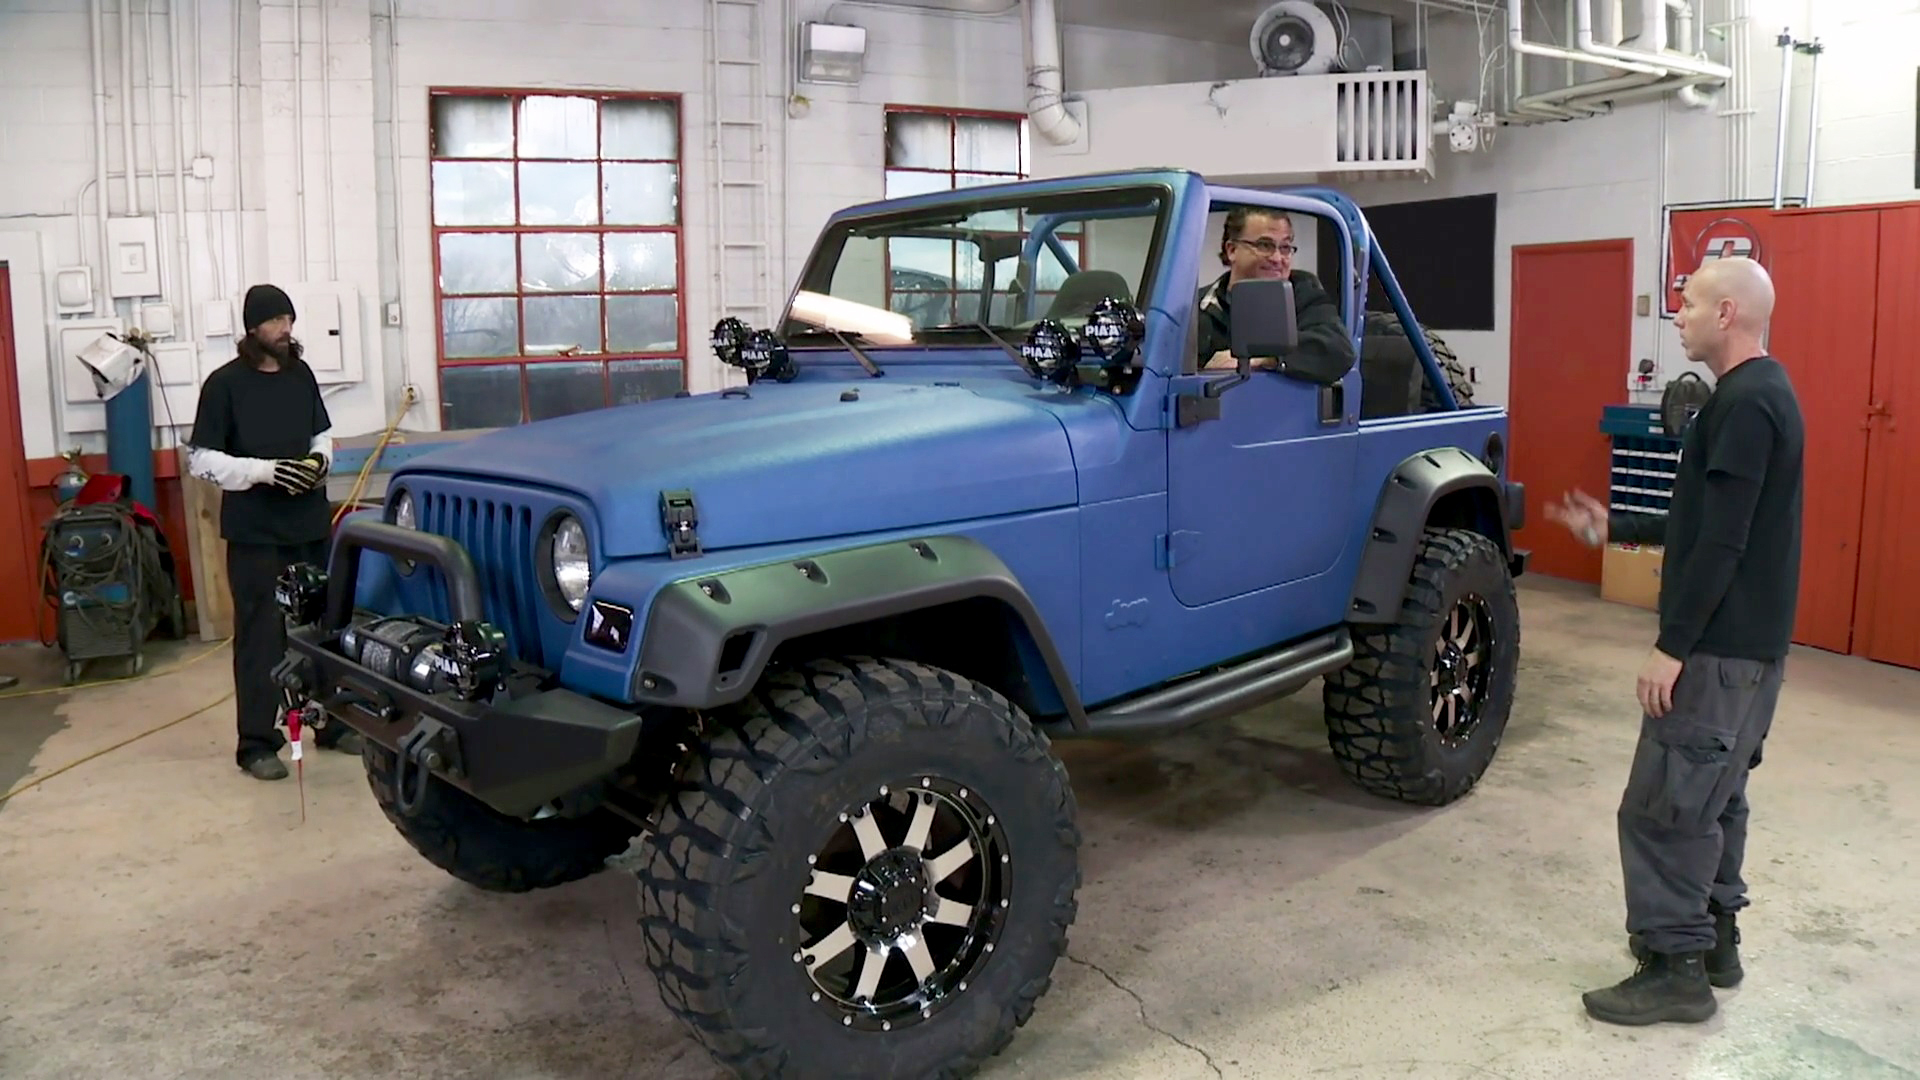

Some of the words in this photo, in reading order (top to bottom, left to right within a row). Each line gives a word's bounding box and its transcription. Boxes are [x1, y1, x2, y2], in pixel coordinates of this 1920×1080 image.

[1085, 325, 1119, 336] PIAA
[741, 351, 765, 360] PIAA
[1022, 346, 1053, 358] PIAA
[434, 656, 461, 677] PIAA
